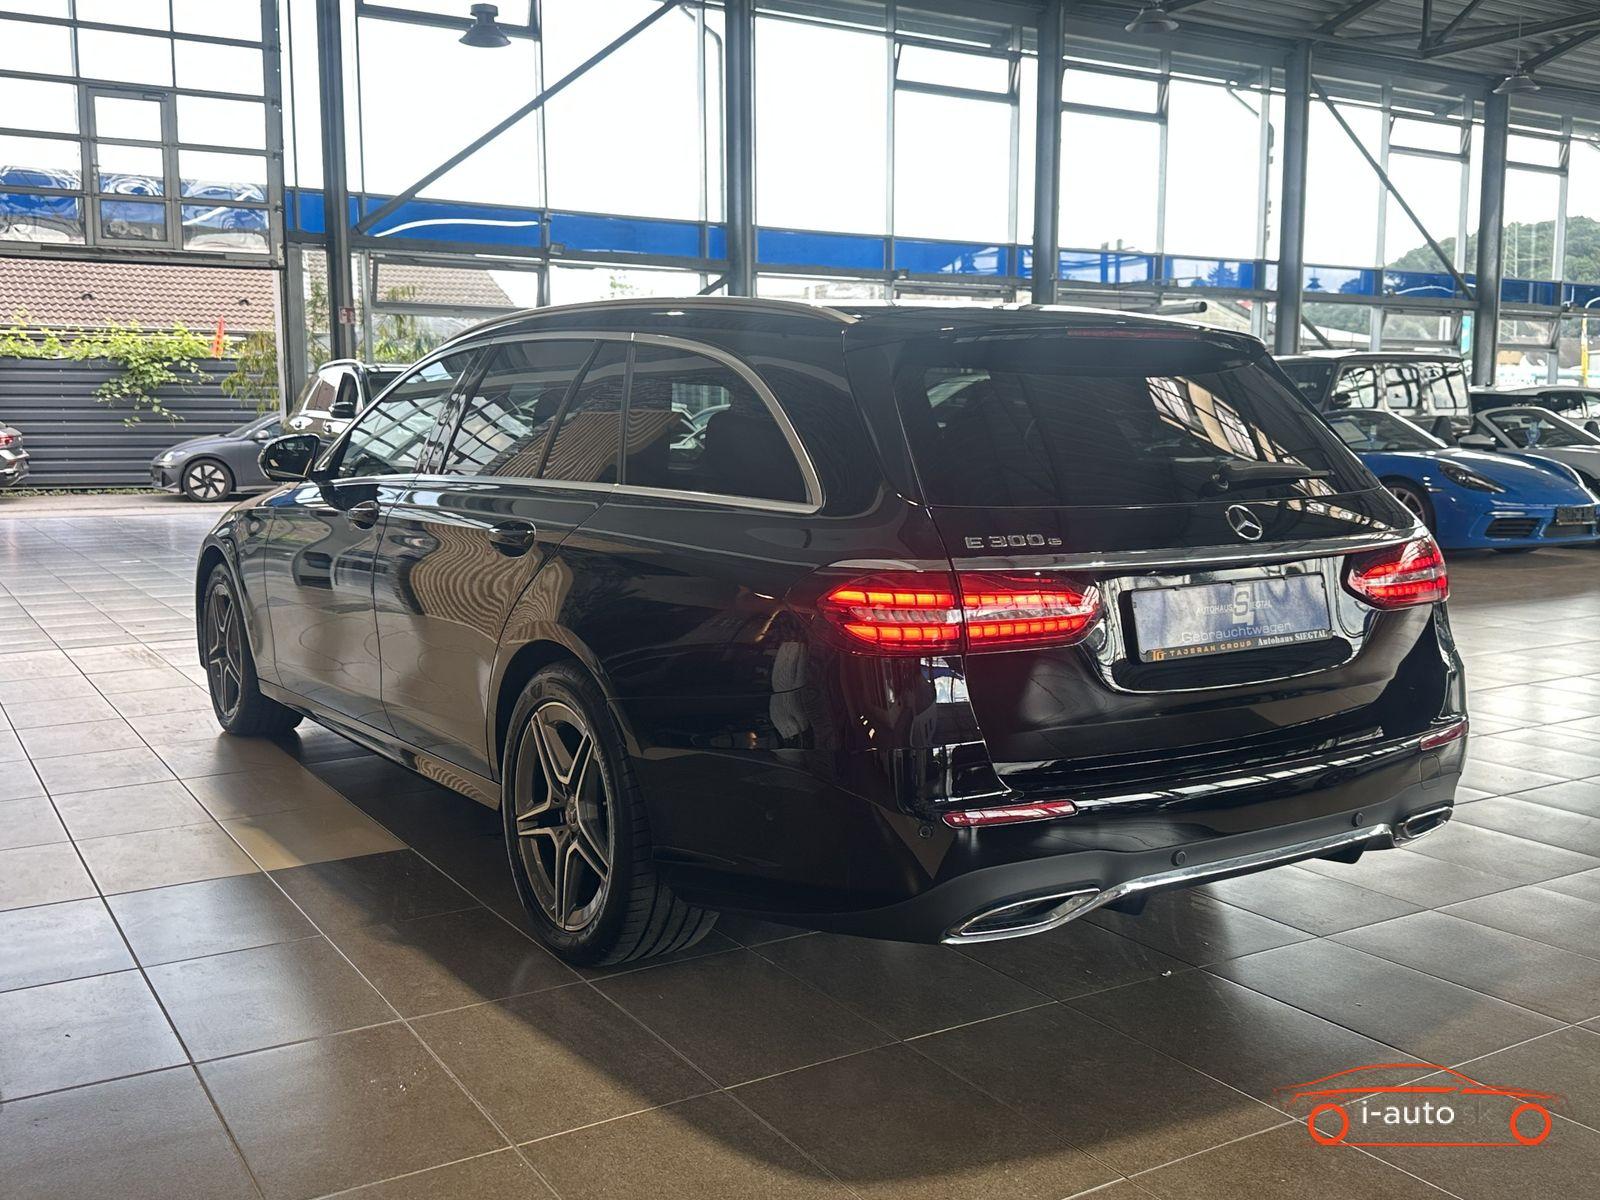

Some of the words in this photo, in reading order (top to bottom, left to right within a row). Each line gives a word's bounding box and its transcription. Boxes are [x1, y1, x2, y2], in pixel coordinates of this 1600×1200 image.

[964, 536, 984, 549] E
[1195, 603, 1233, 616] AUTOHAUS
[1181, 621, 1291, 644] Gebrauchtwagen
[1169, 645, 1216, 657] TAJERAN
[1220, 640, 1252, 651] GROUP
[1258, 635, 1294, 646] Autohaus
[1295, 629, 1328, 641] SIEGTAL
